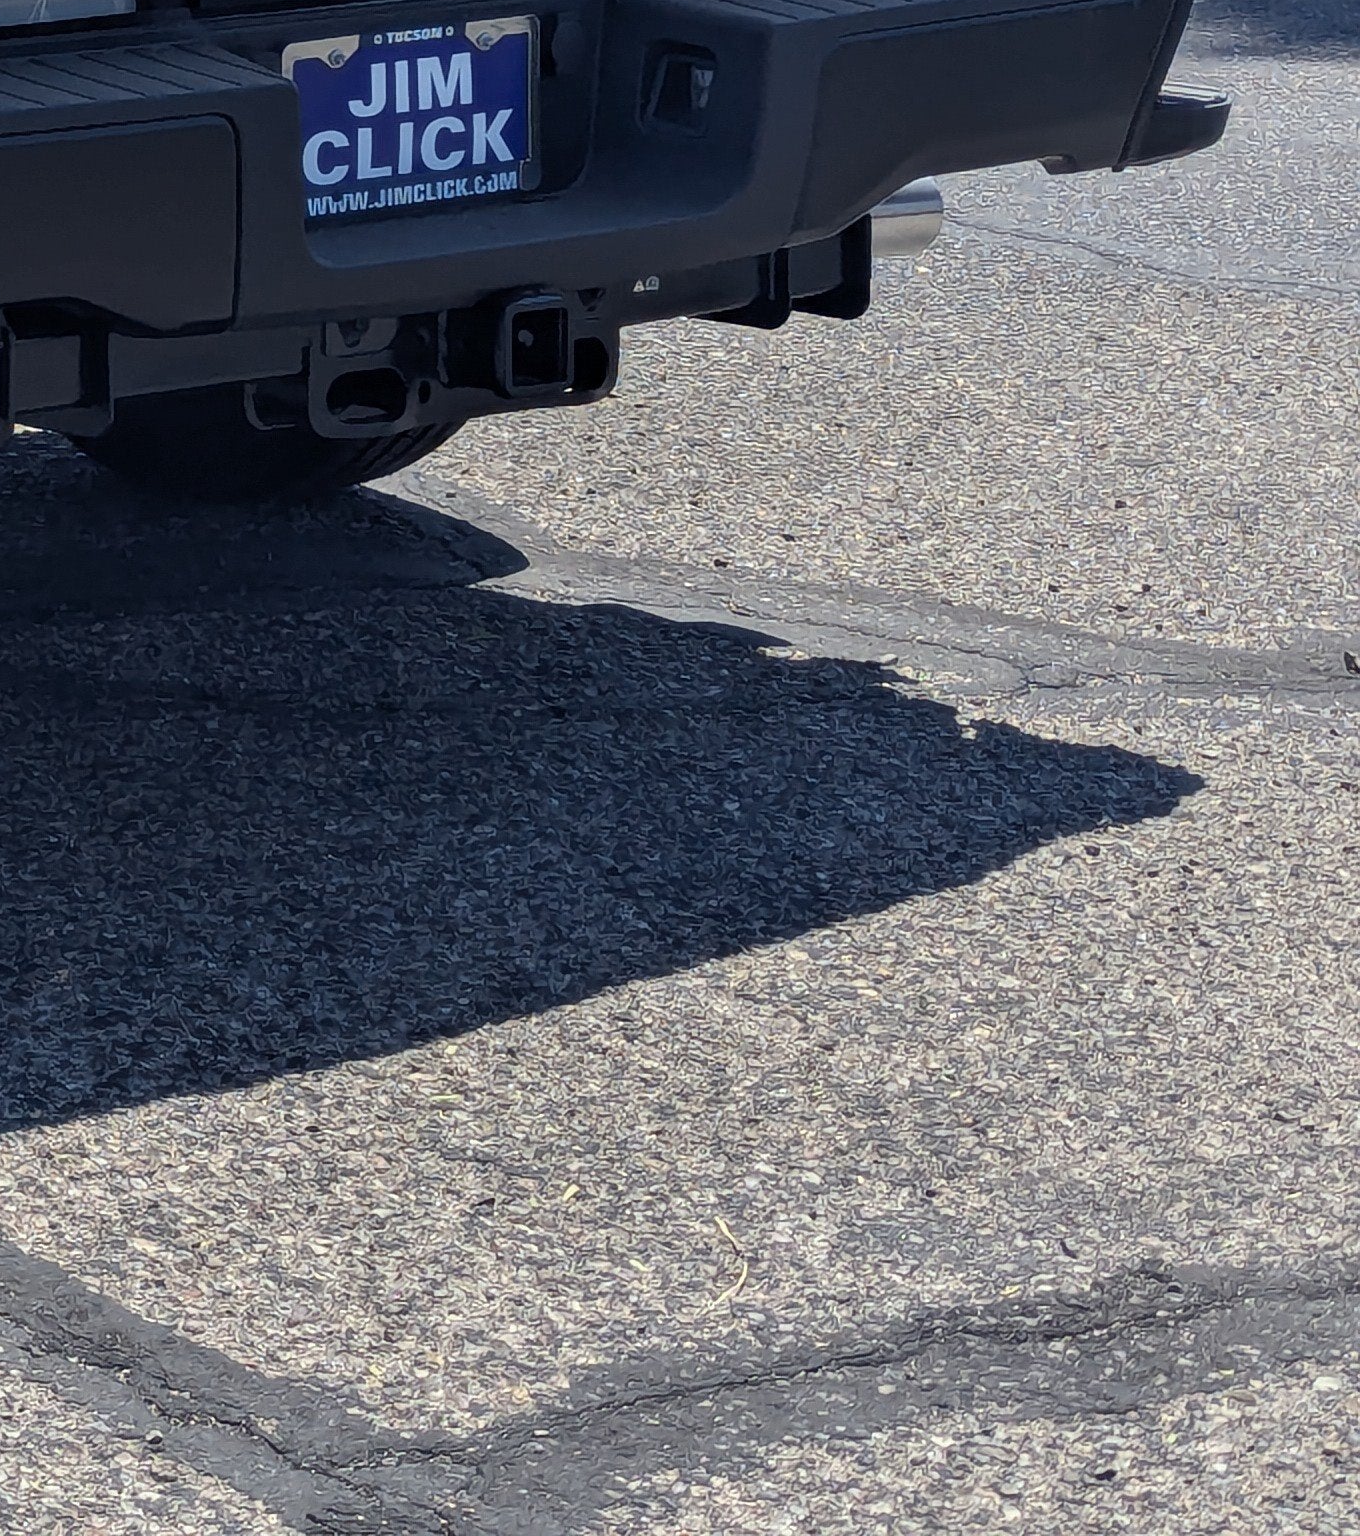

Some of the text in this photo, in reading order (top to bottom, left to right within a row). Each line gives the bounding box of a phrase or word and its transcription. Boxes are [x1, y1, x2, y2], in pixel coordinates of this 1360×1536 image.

[385, 26, 444, 45] TUCSON
[347, 52, 473, 118] JIM
[302, 108, 515, 186] CLICK
[306, 170, 518, 217] WWW.JIMCLICK.COM
